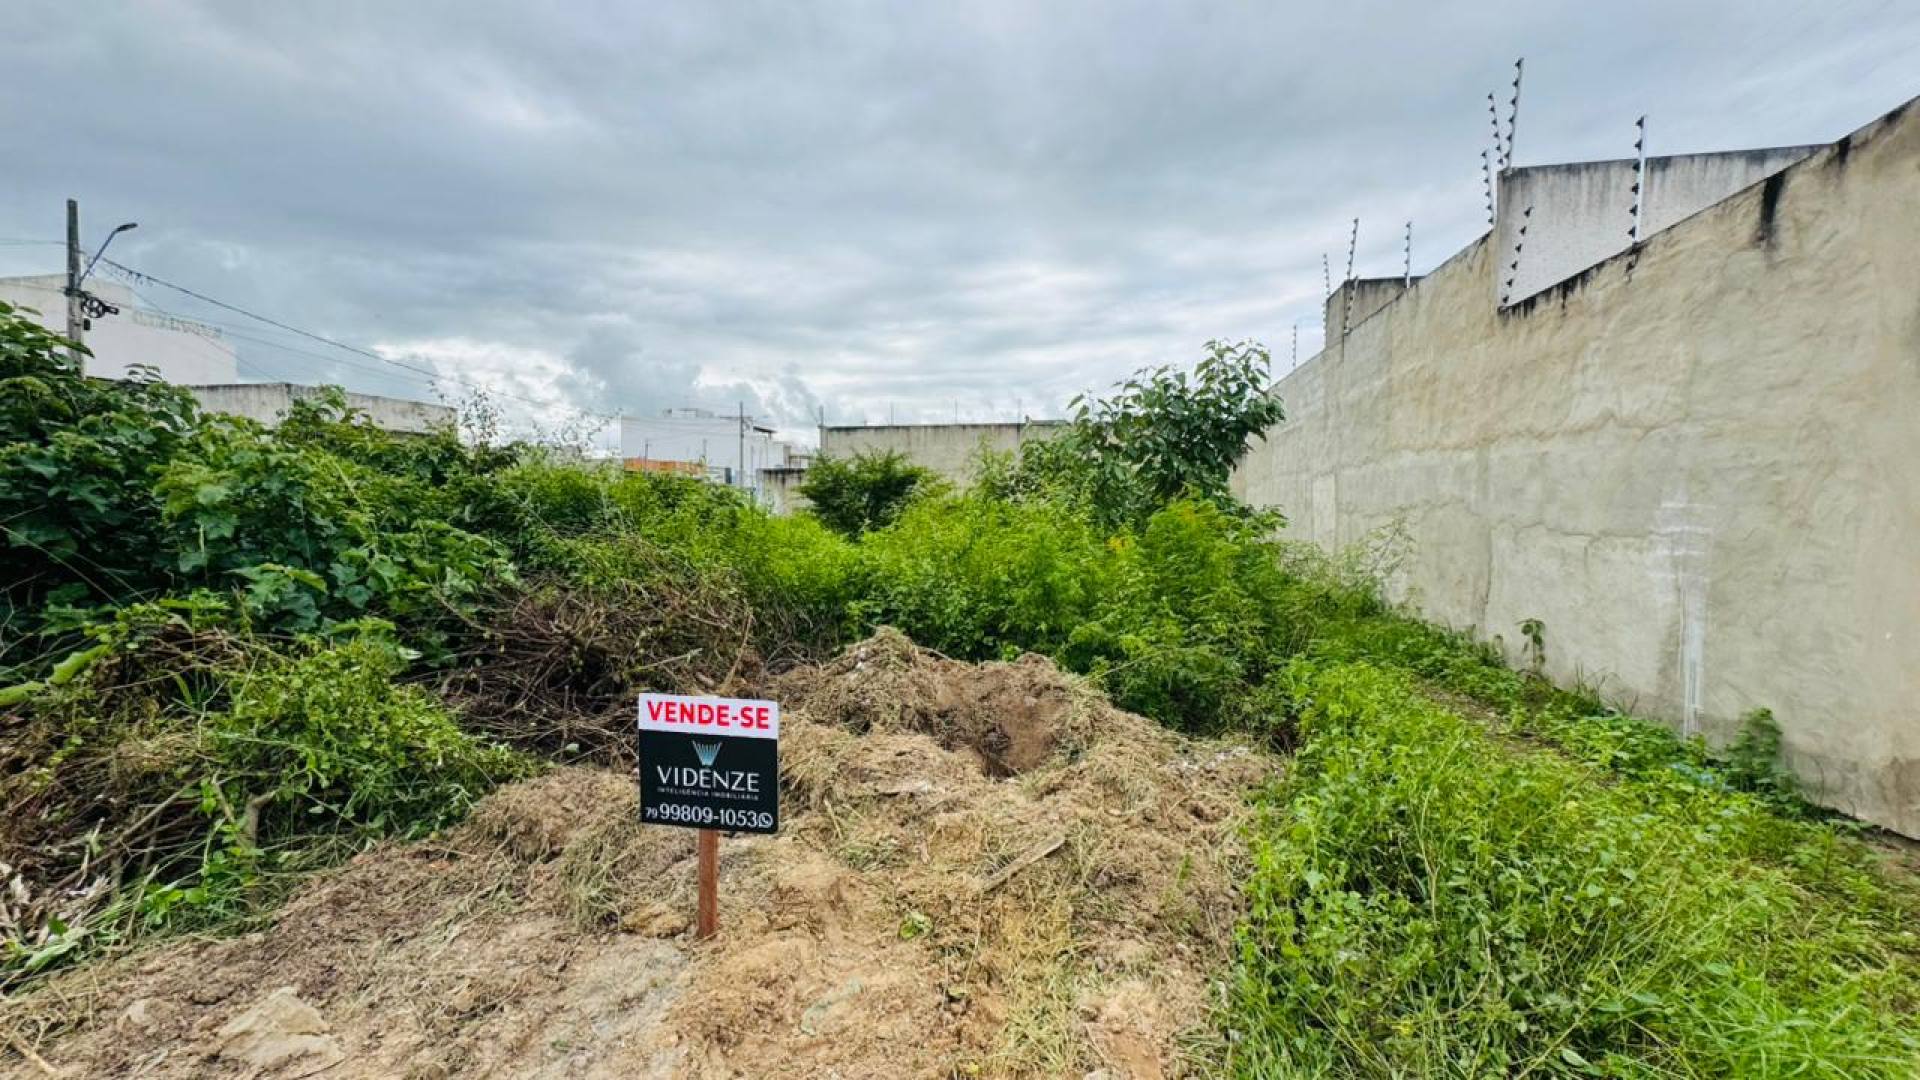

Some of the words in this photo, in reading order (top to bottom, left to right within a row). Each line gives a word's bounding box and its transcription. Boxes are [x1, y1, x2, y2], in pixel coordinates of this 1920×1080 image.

[647, 701, 770, 729] VENDE-SE
[657, 765, 760, 793] VIDENZE
[645, 807, 658, 819] 79
[659, 803, 757, 827] 99809-1053
